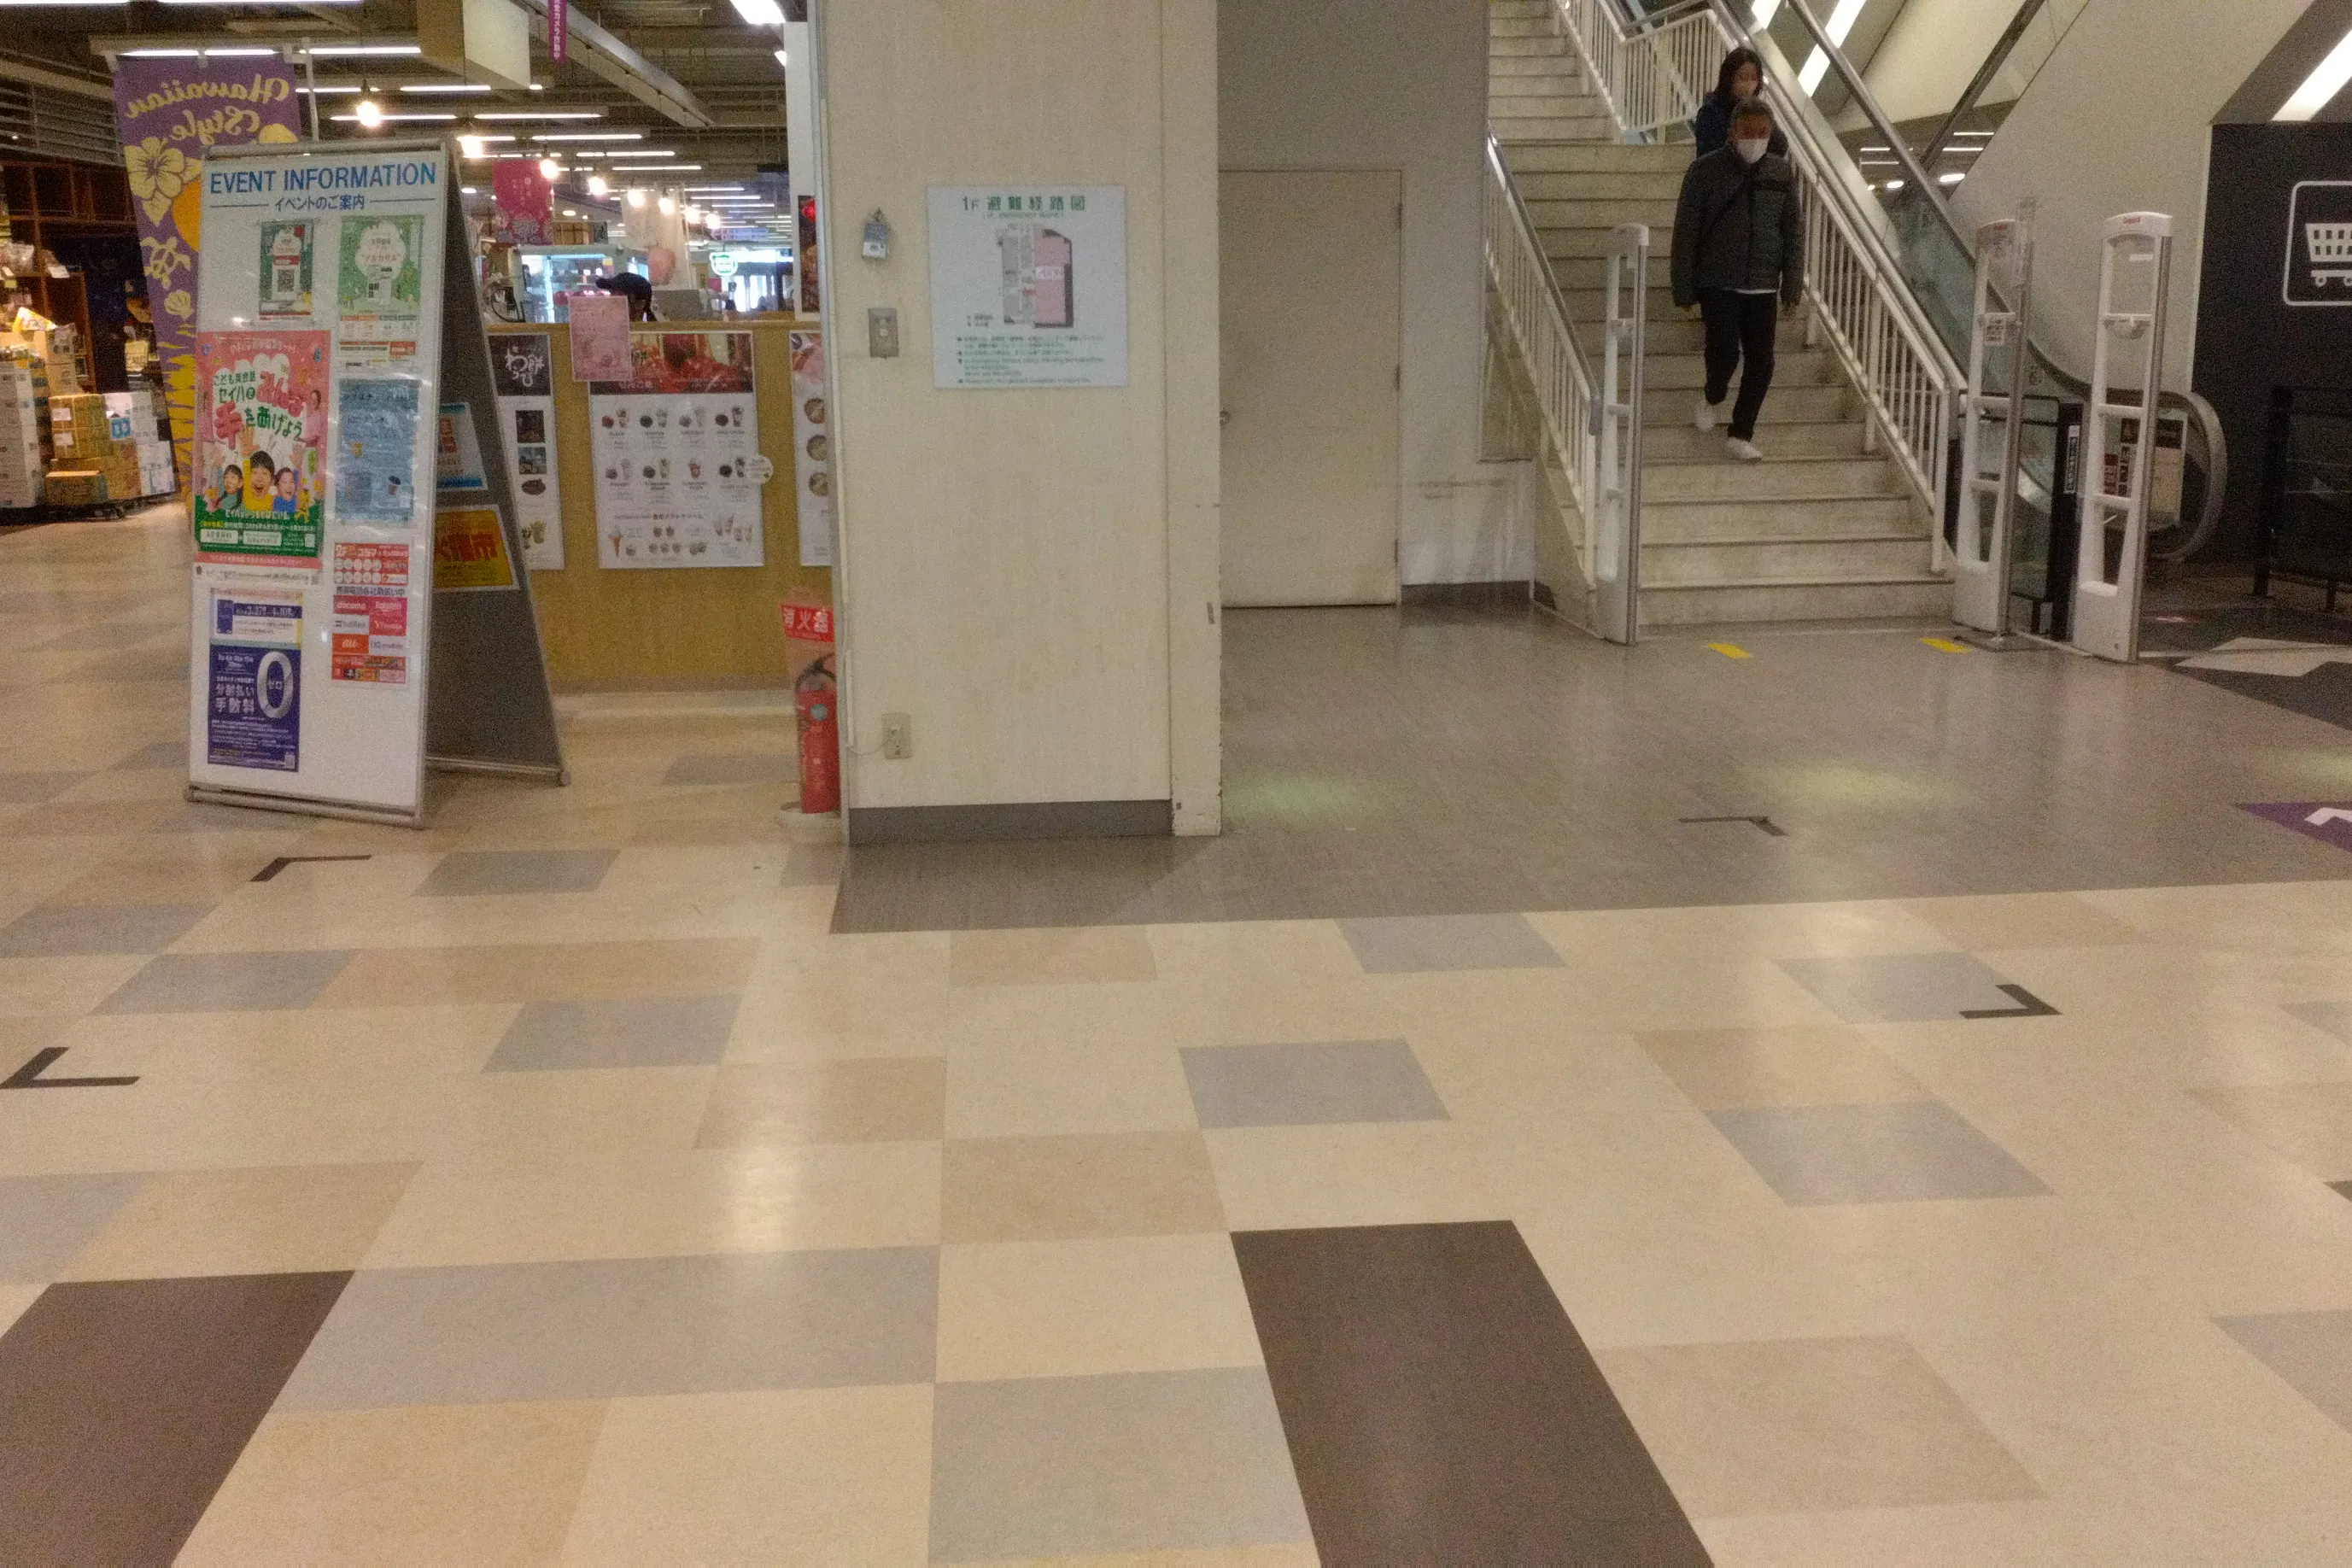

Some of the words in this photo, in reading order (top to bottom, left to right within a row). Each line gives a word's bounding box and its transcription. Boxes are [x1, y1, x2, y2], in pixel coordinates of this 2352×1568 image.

[210, 169, 277, 194] EVENT
[284, 162, 436, 191] INFORMATION
[274, 194, 366, 212] イベントのご案内
[987, 196, 1085, 211] 避難経路図
[213, 370, 256, 386] こども英会話
